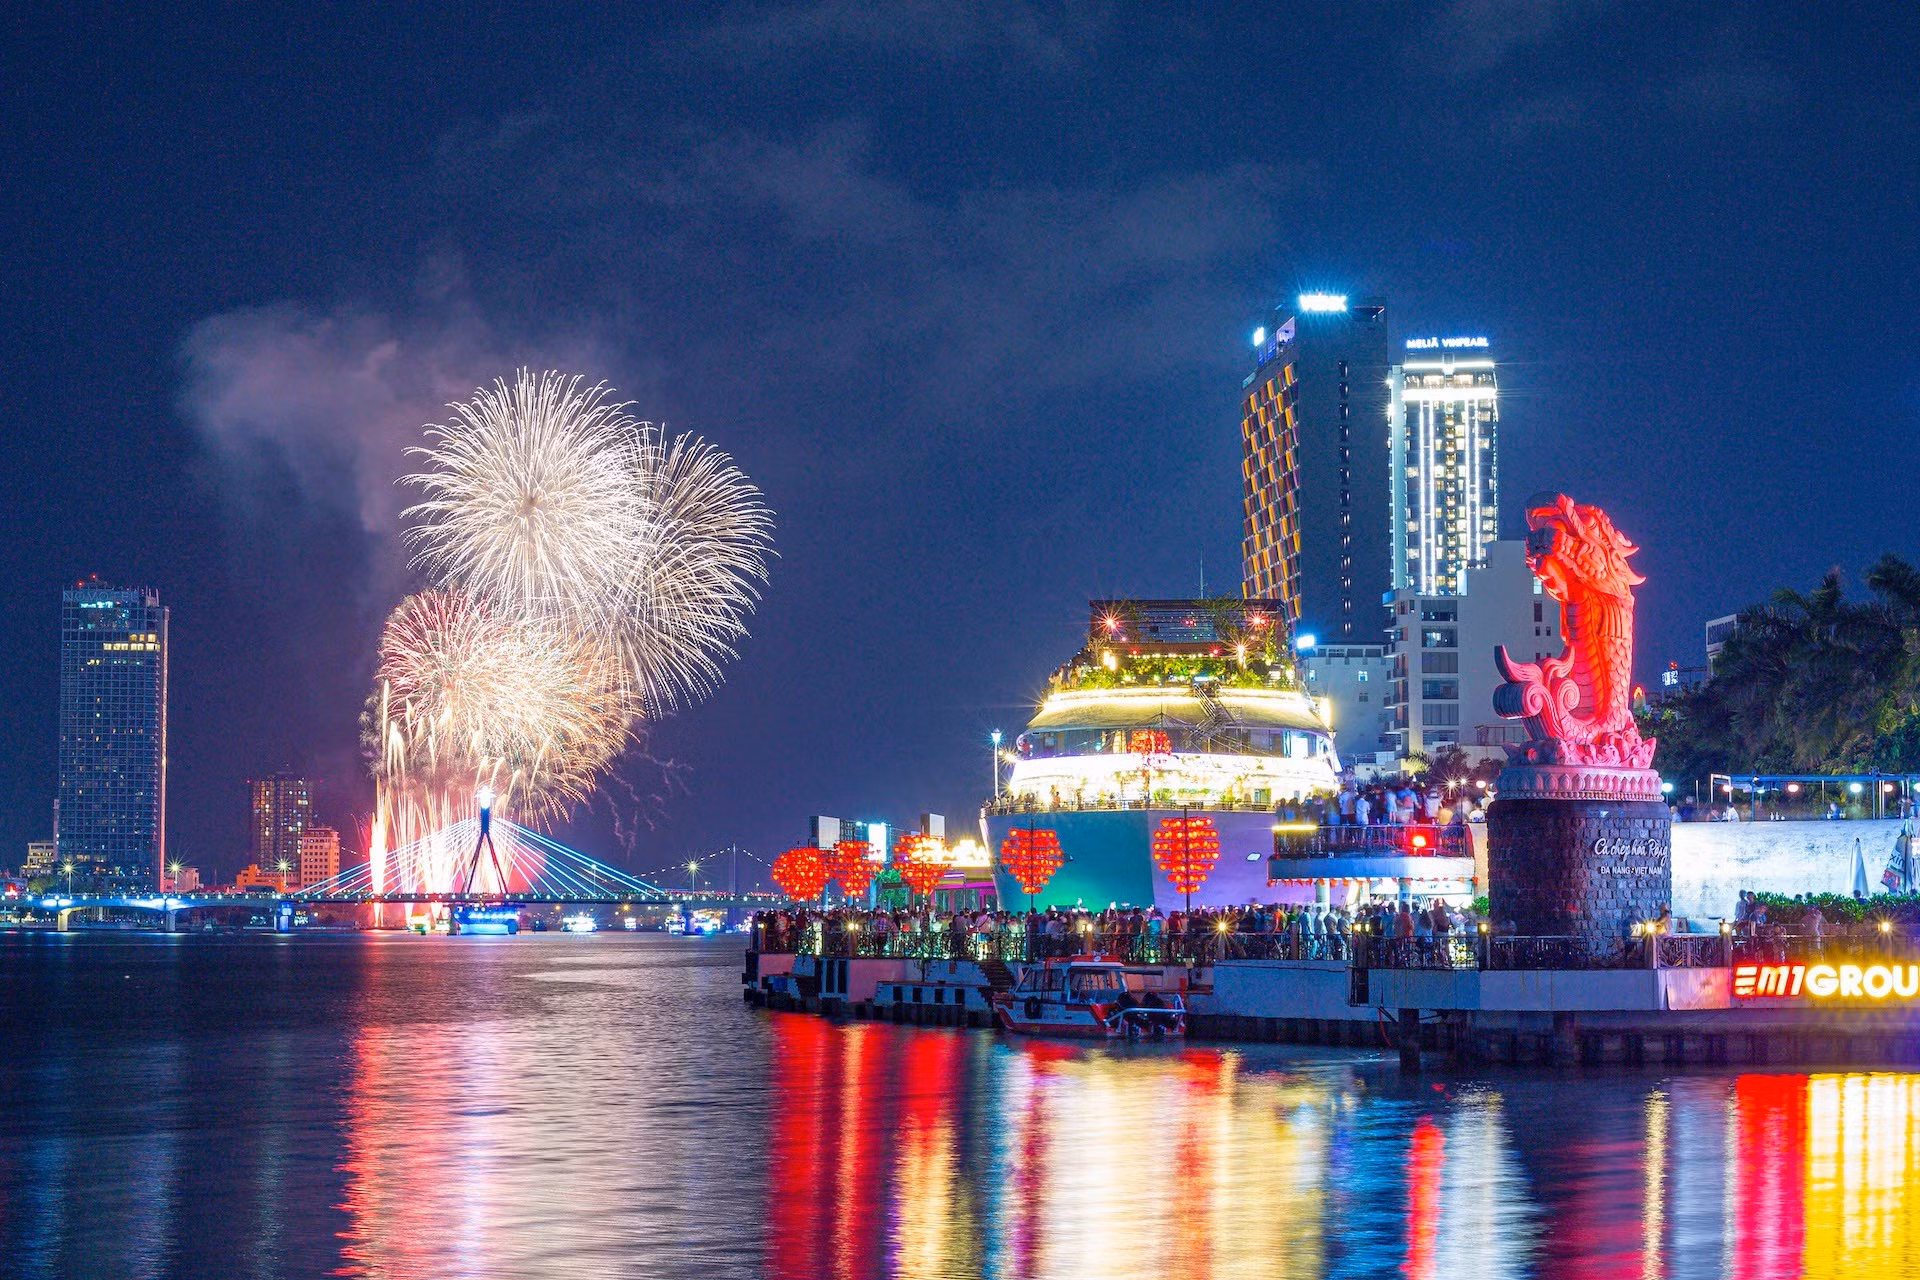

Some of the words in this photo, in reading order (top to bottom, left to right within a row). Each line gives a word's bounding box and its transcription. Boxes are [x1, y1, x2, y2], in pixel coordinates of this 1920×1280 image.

[1441, 336, 1489, 348] VINPEARL
[63, 590, 140, 602] NOVOTEL
[1648, 866, 1662, 875] NAM
